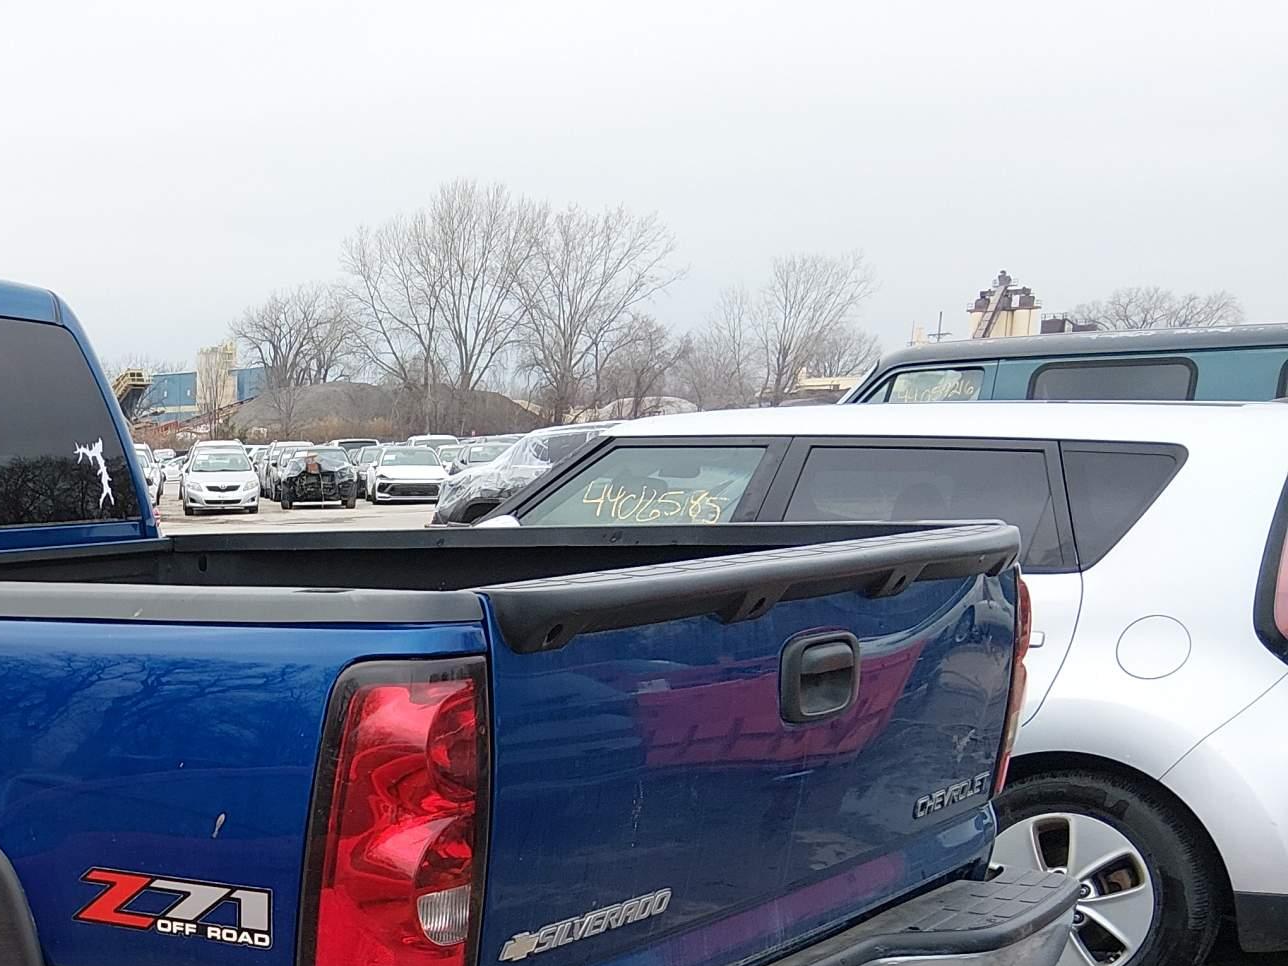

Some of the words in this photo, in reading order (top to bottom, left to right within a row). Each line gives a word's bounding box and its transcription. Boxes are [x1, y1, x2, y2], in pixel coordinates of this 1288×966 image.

[914, 771, 991, 819] CHEVROLET
[75, 868, 270, 930] Z71
[534, 888, 672, 953] SILVERADO
[156, 919, 198, 936] OFF
[206, 926, 271, 947] ROAD
